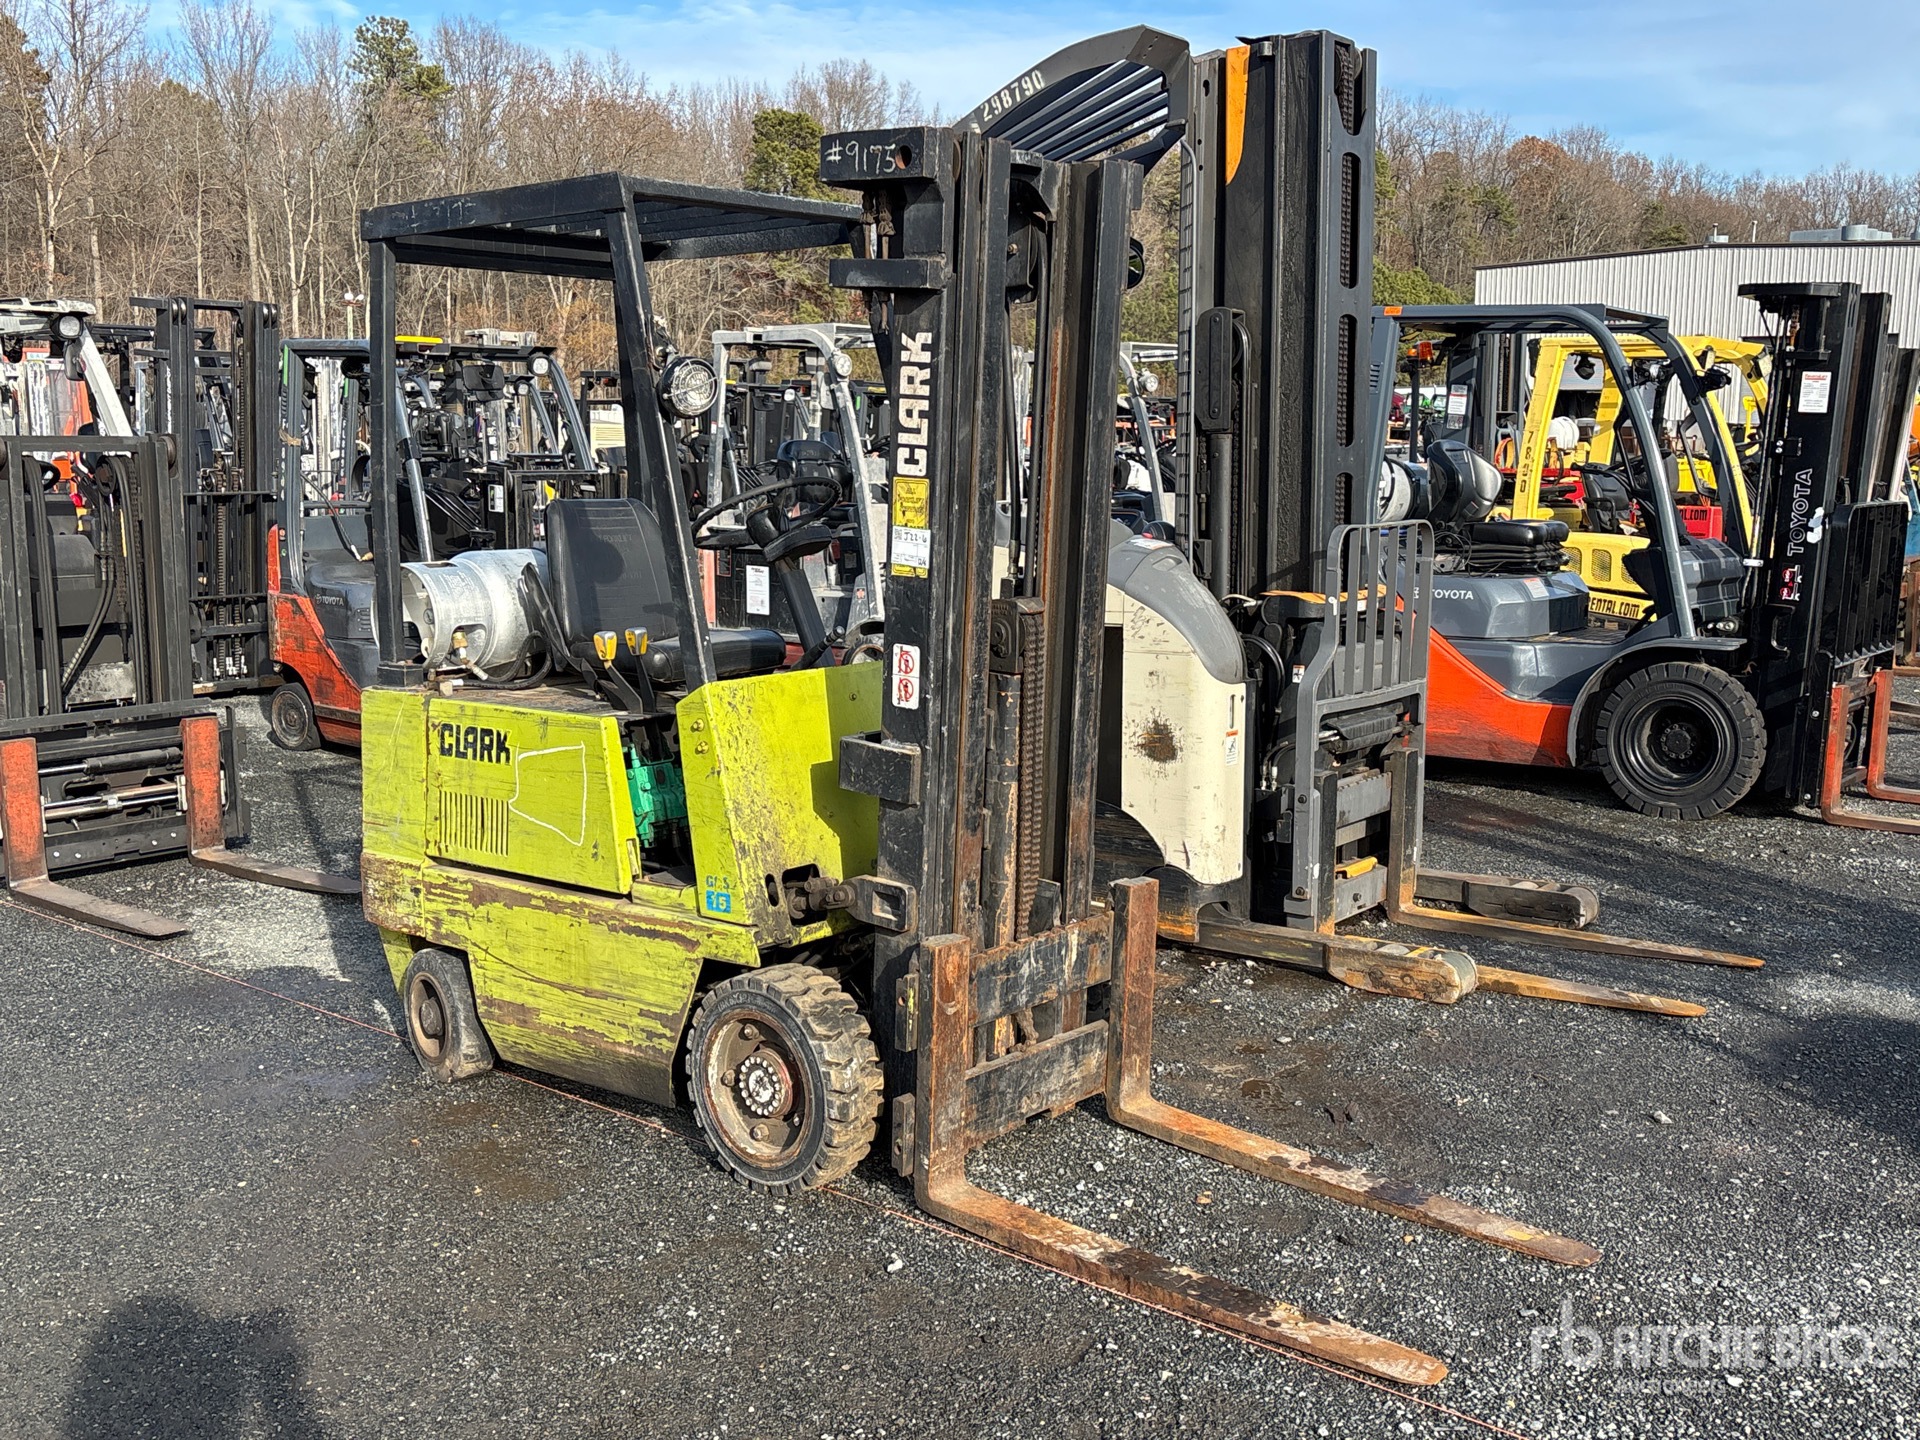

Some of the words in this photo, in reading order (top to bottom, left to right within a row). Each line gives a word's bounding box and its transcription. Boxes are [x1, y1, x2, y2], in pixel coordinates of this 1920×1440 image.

[980, 69, 1045, 122] 298790
[824, 139, 897, 175] #9175
[896, 332, 933, 477] CLARK
[1786, 468, 1814, 557] TOYOTA
[322, 595, 345, 607] TOYOTA
[1432, 588, 1474, 600] TOYOTA
[439, 723, 511, 766] CLARK
